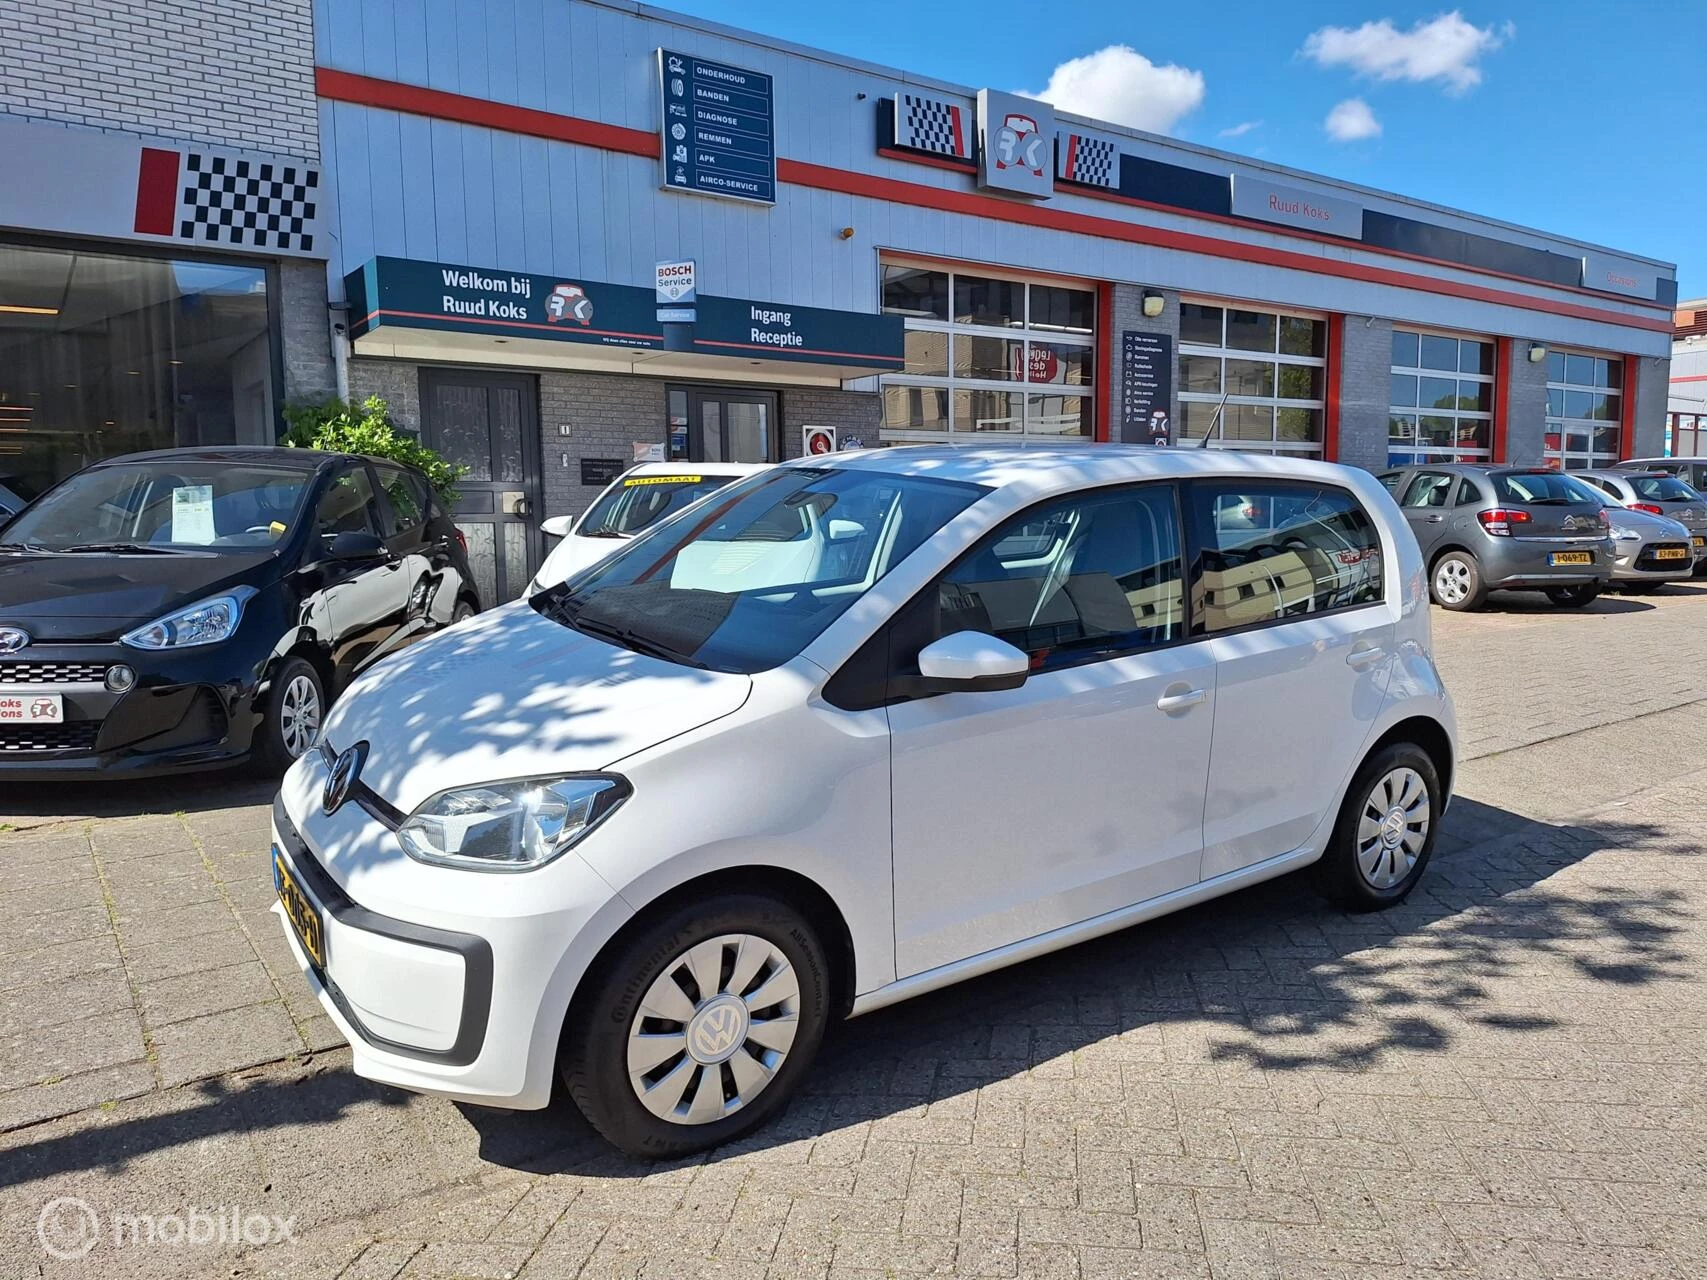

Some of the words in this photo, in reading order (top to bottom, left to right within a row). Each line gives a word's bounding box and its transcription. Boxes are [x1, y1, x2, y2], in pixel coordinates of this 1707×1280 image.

[696, 66, 746, 84] ONDERHOUD
[697, 89, 730, 102] BANDEN
[697, 111, 738, 126] DIAGNOSE
[698, 132, 732, 145] REMMEN
[699, 153, 716, 163] APK
[699, 175, 759, 192] AIRCO-SERVICE
[1269, 195, 1299, 214] Ruud
[1303, 203, 1330, 221] Koks
[658, 265, 692, 277] BOSCH
[441, 269, 508, 293] Welkom
[511, 275, 531, 298] bij
[658, 277, 692, 287] Service
[442, 295, 485, 317] Ruud
[489, 300, 528, 320] Koks
[751, 306, 792, 327] Ingang
[751, 327, 803, 347] Receptie
